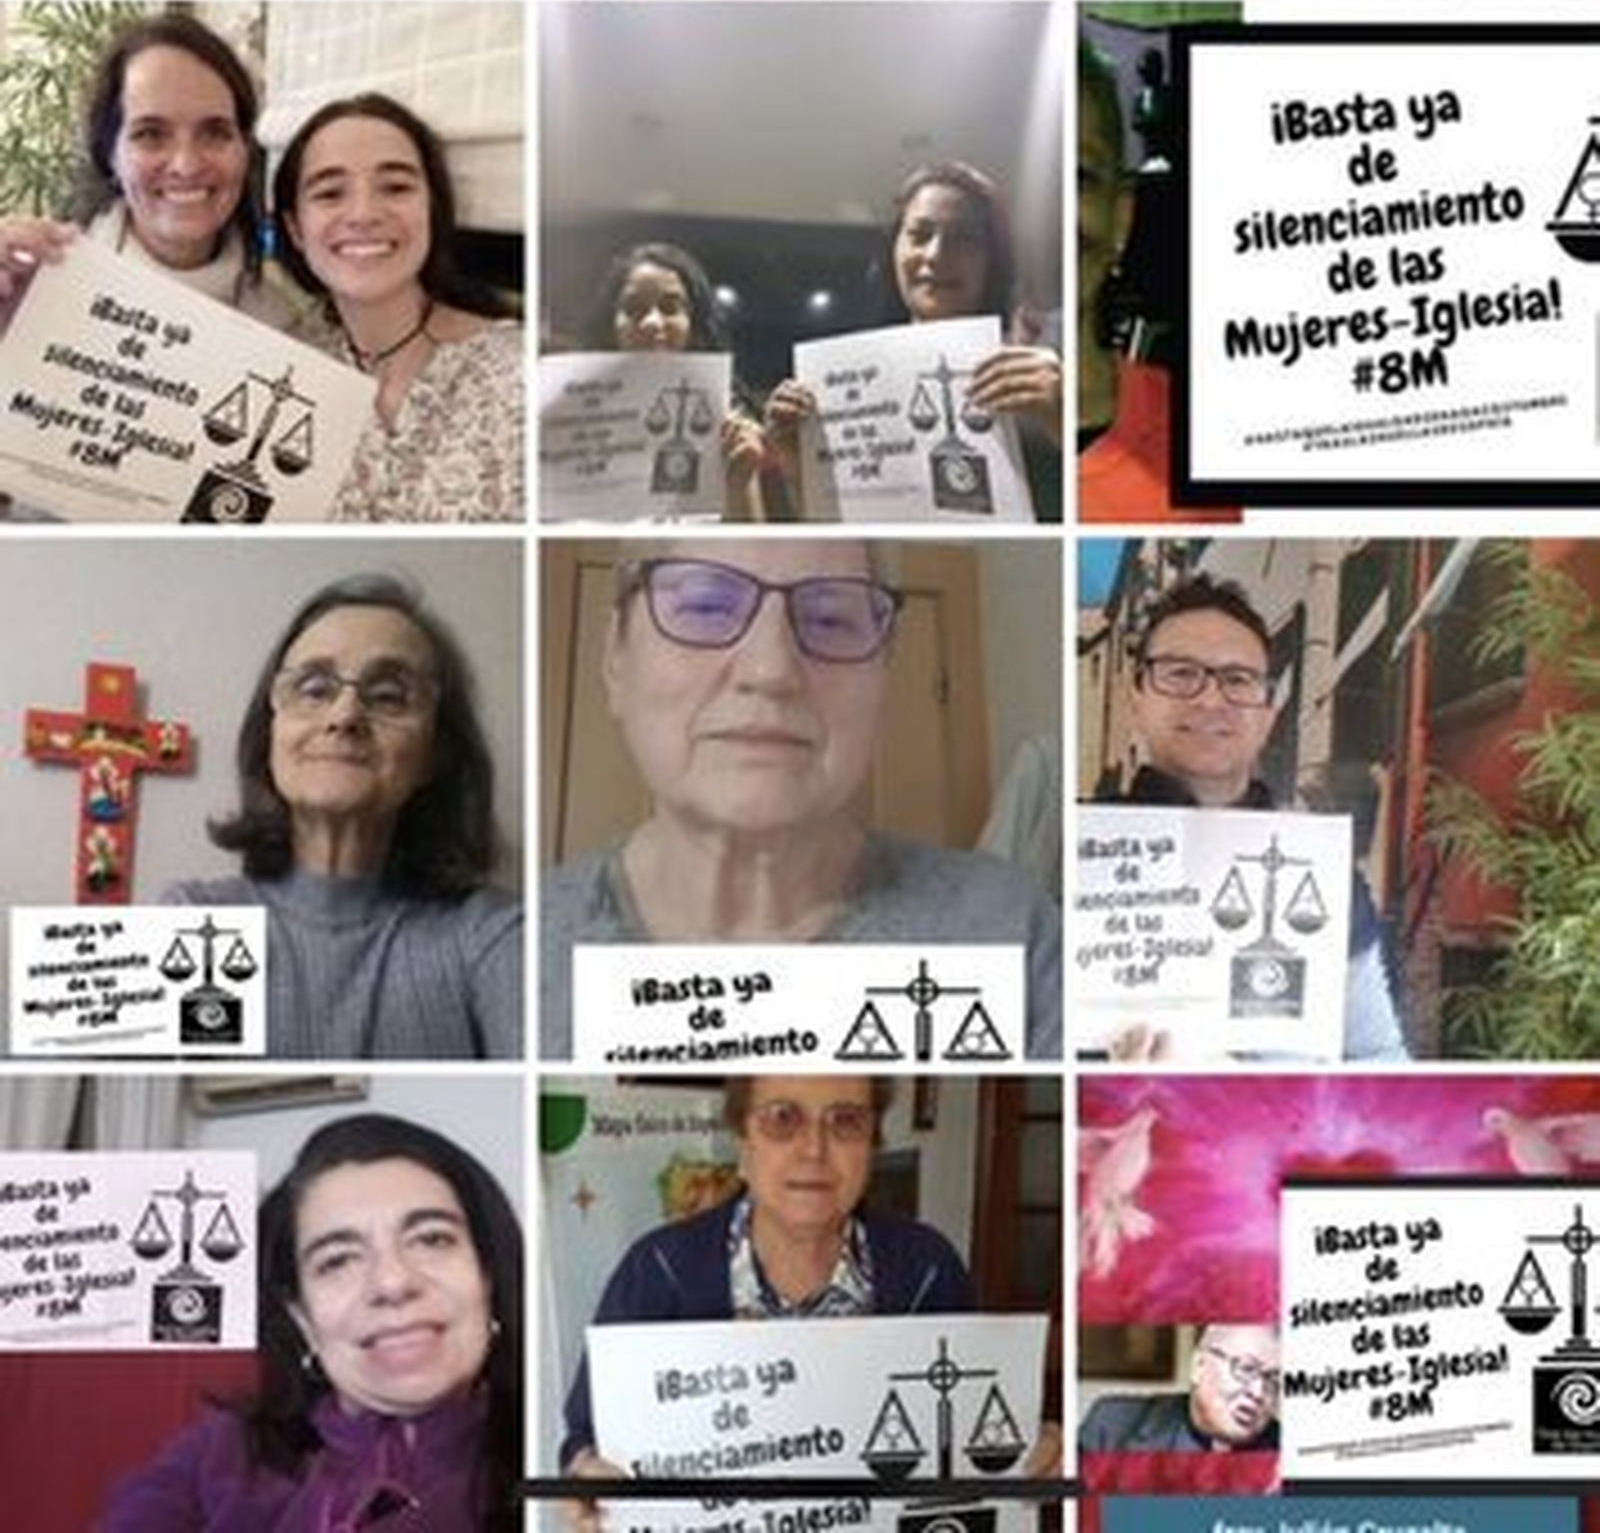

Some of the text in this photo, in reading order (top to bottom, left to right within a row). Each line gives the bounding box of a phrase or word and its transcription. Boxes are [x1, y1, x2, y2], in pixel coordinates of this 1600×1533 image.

[1407, 88, 1464, 140] ya
[1345, 141, 1400, 187] de
[1233, 180, 1526, 255] silenciamiento
[1326, 246, 1447, 295] de las
[1350, 342, 1450, 395] #8M
[1076, 884, 1201, 911] lenciamiento
[731, 970, 774, 1005] ya
[687, 1003, 727, 1033] de
[0, 1223, 120, 1251] enciamiento
[1405, 1217, 1443, 1253] ya
[0, 1266, 136, 1306] jeres-Iglesia!
[1365, 1254, 1400, 1283] de
[1290, 1279, 1484, 1328] silenciamiento
[1351, 1321, 1431, 1355] de las
[756, 1356, 798, 1397] ya
[712, 1399, 752, 1433] de
[1368, 1389, 1435, 1421] #8M
